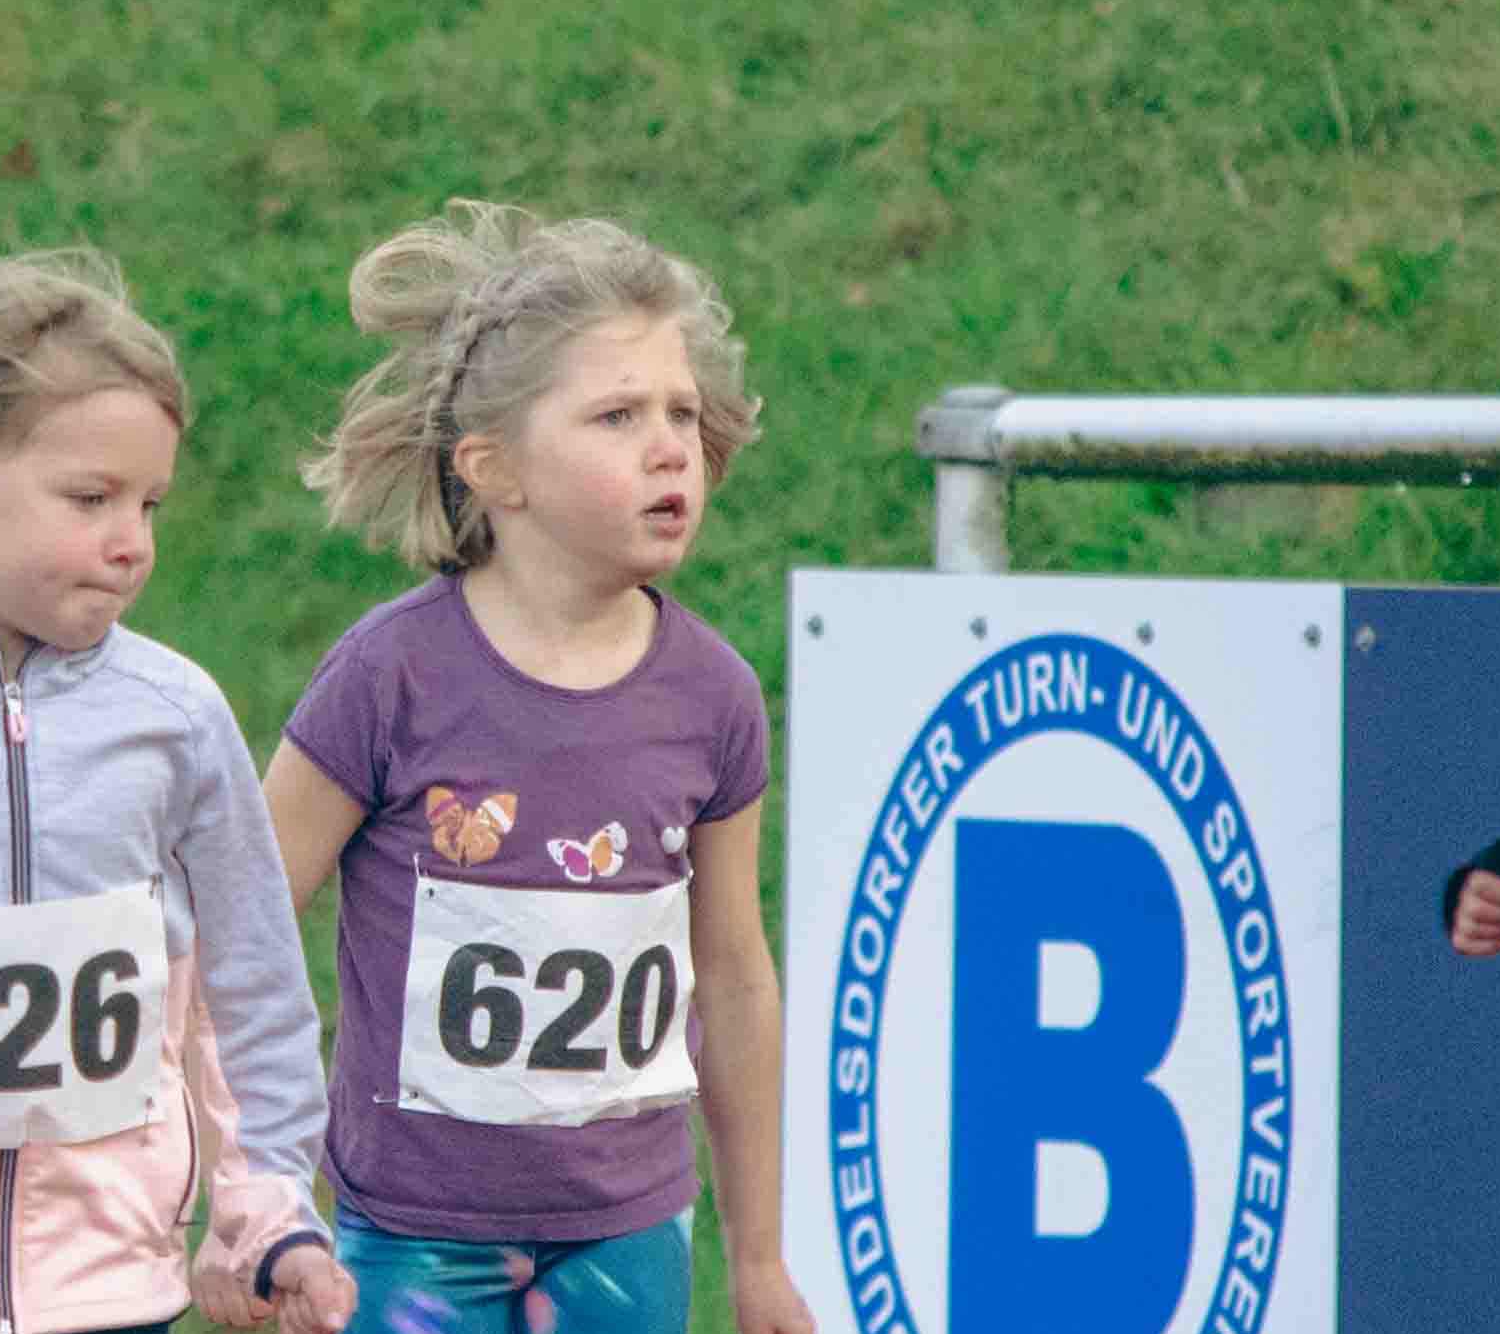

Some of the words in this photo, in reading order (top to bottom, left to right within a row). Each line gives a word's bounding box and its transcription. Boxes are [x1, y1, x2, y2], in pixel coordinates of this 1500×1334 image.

[964, 650, 1105, 745] TURN-
[1117, 671, 1205, 802] UND
[438, 943, 677, 1073] 620
